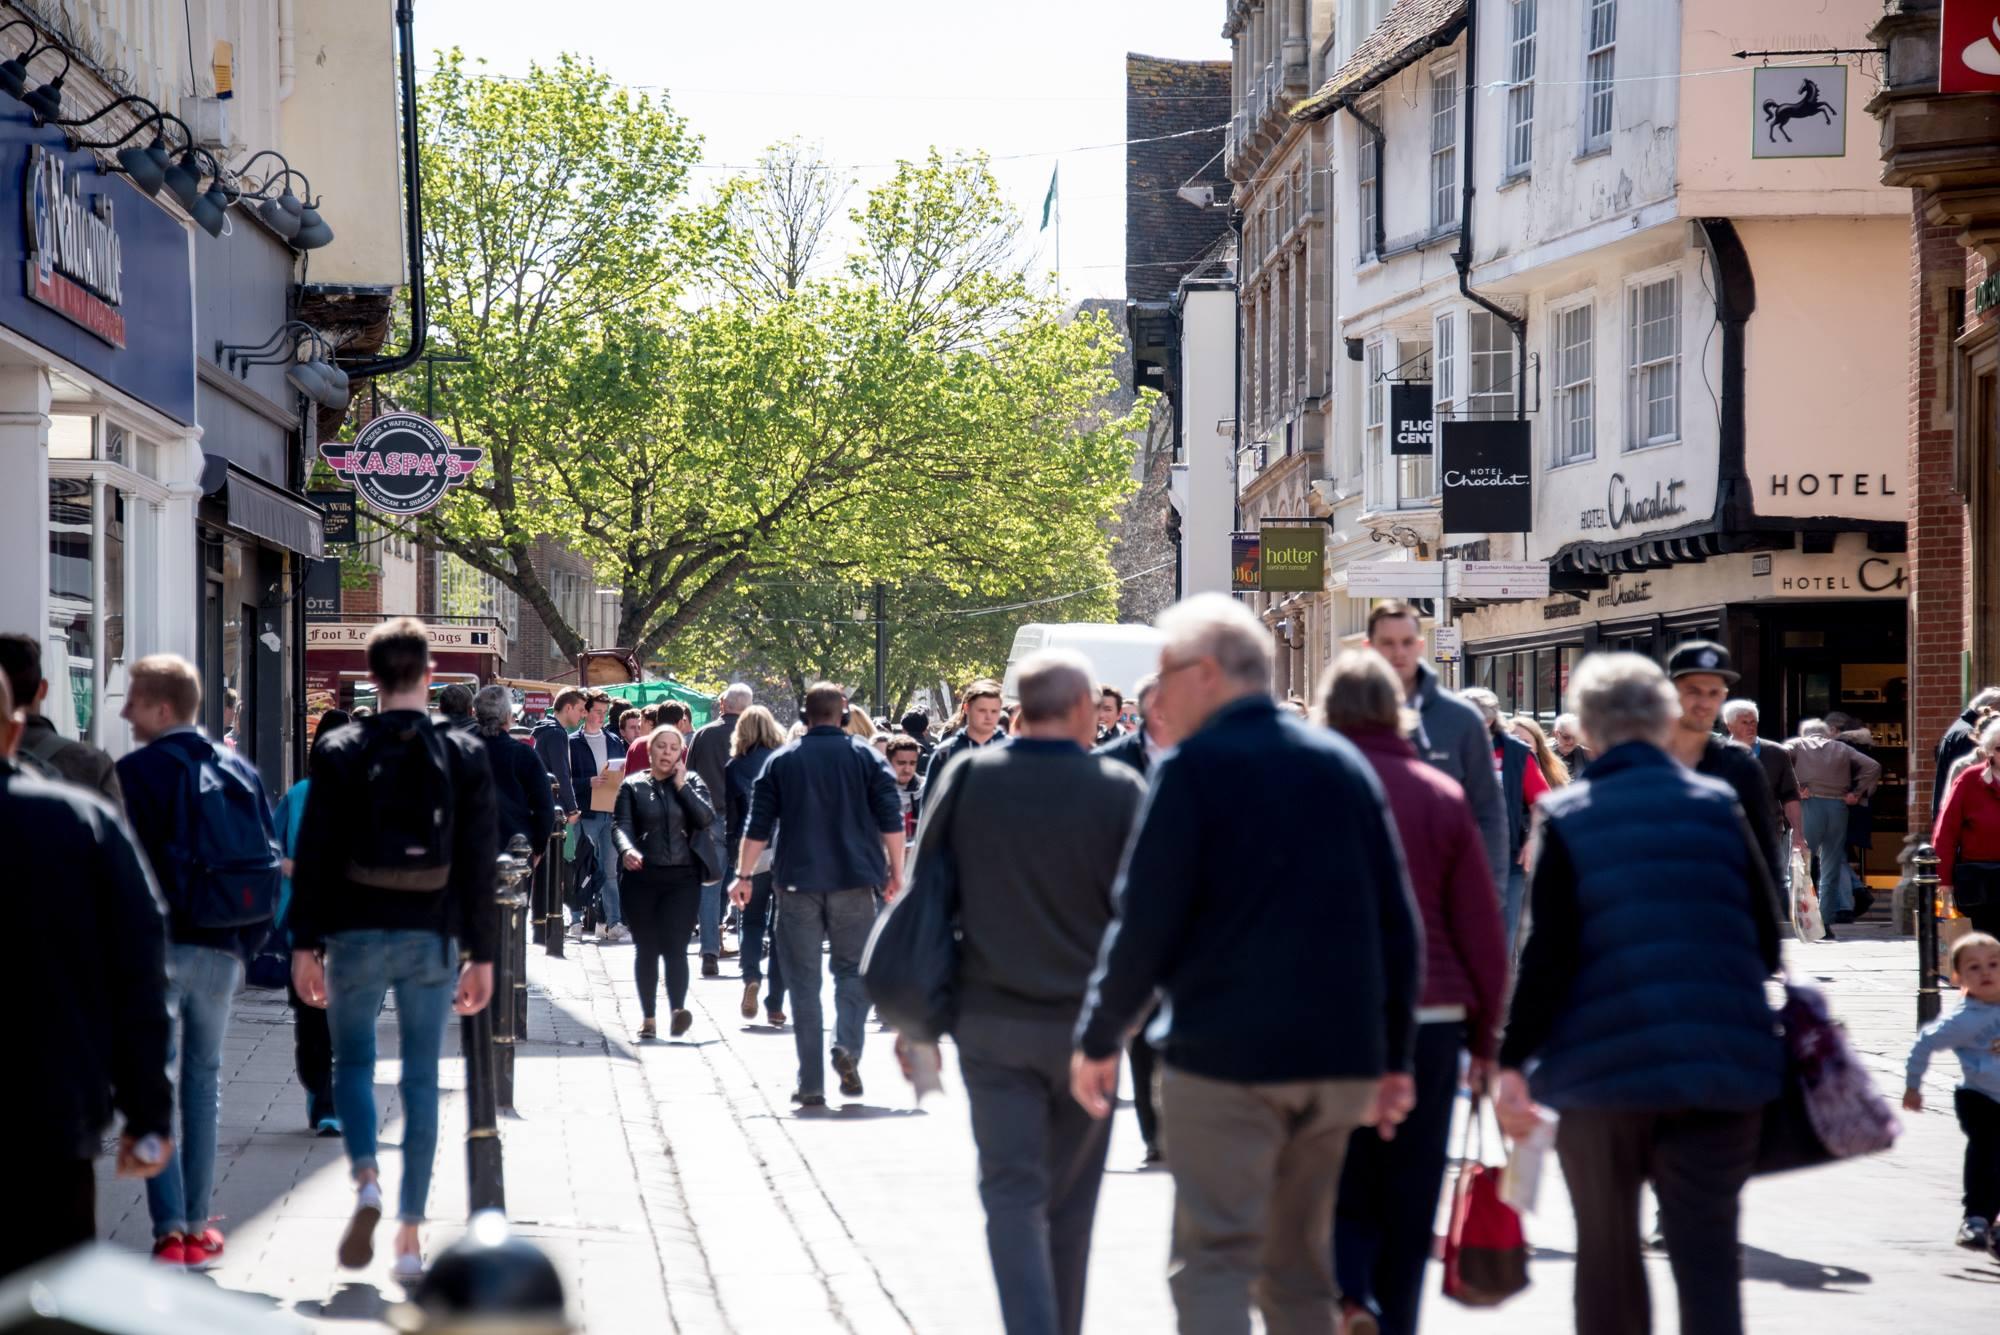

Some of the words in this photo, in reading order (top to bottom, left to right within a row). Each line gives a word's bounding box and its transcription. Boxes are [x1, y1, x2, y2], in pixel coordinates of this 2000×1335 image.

[388, 420, 417, 429] WAFFLES
[422, 428, 442, 448] COFFEE
[1401, 420, 1432, 431] FLIG
[1397, 433, 1432, 443] CENT
[344, 450, 462, 477] KASPA'S
[1771, 473, 1896, 496] HOTEL
[369, 486, 379, 498] ICE
[377, 495, 399, 507] CREAM
[408, 492, 432, 507] SHAKES
[1580, 509, 1607, 530] HOTEL
[1266, 547, 1318, 564] hotter
[1783, 577, 1850, 590] HOTEL
[306, 597, 334, 609] ÔTE
[307, 628, 342, 642] Foot
[347, 628, 366, 640] Lo
